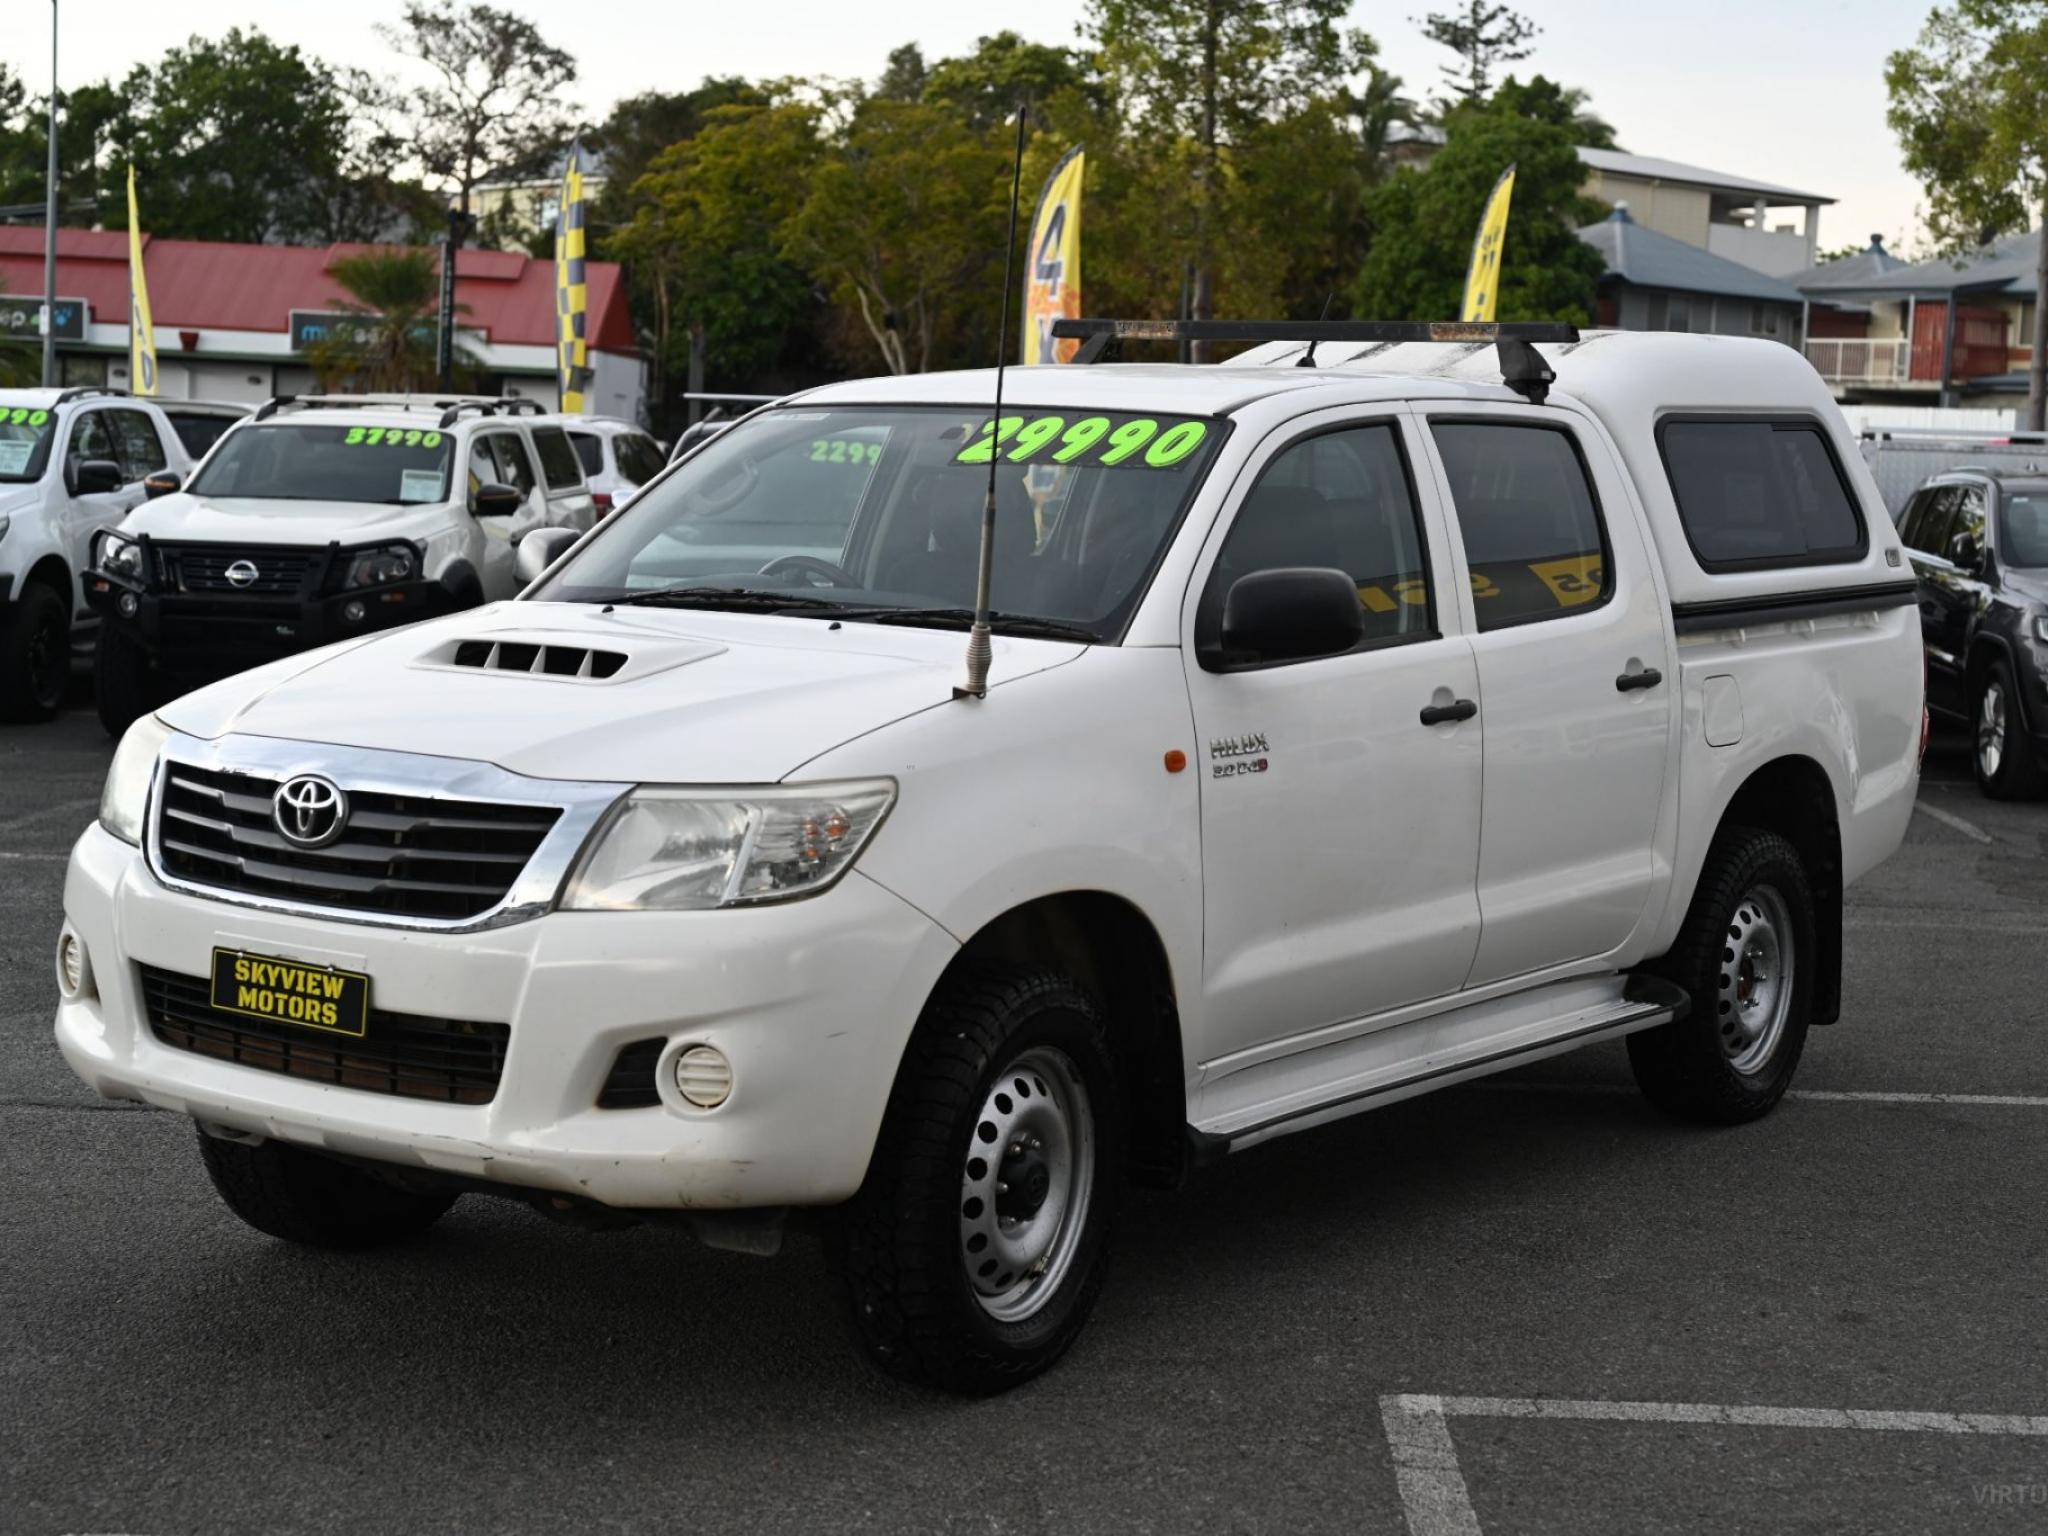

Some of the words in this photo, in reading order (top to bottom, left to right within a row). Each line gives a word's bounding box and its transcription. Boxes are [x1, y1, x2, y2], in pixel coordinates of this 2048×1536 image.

[344, 427, 442, 448] 37990
[956, 416, 1207, 467] 29990
[235, 959, 344, 999] SKYVIEW
[238, 986, 337, 1025] MOTORS
